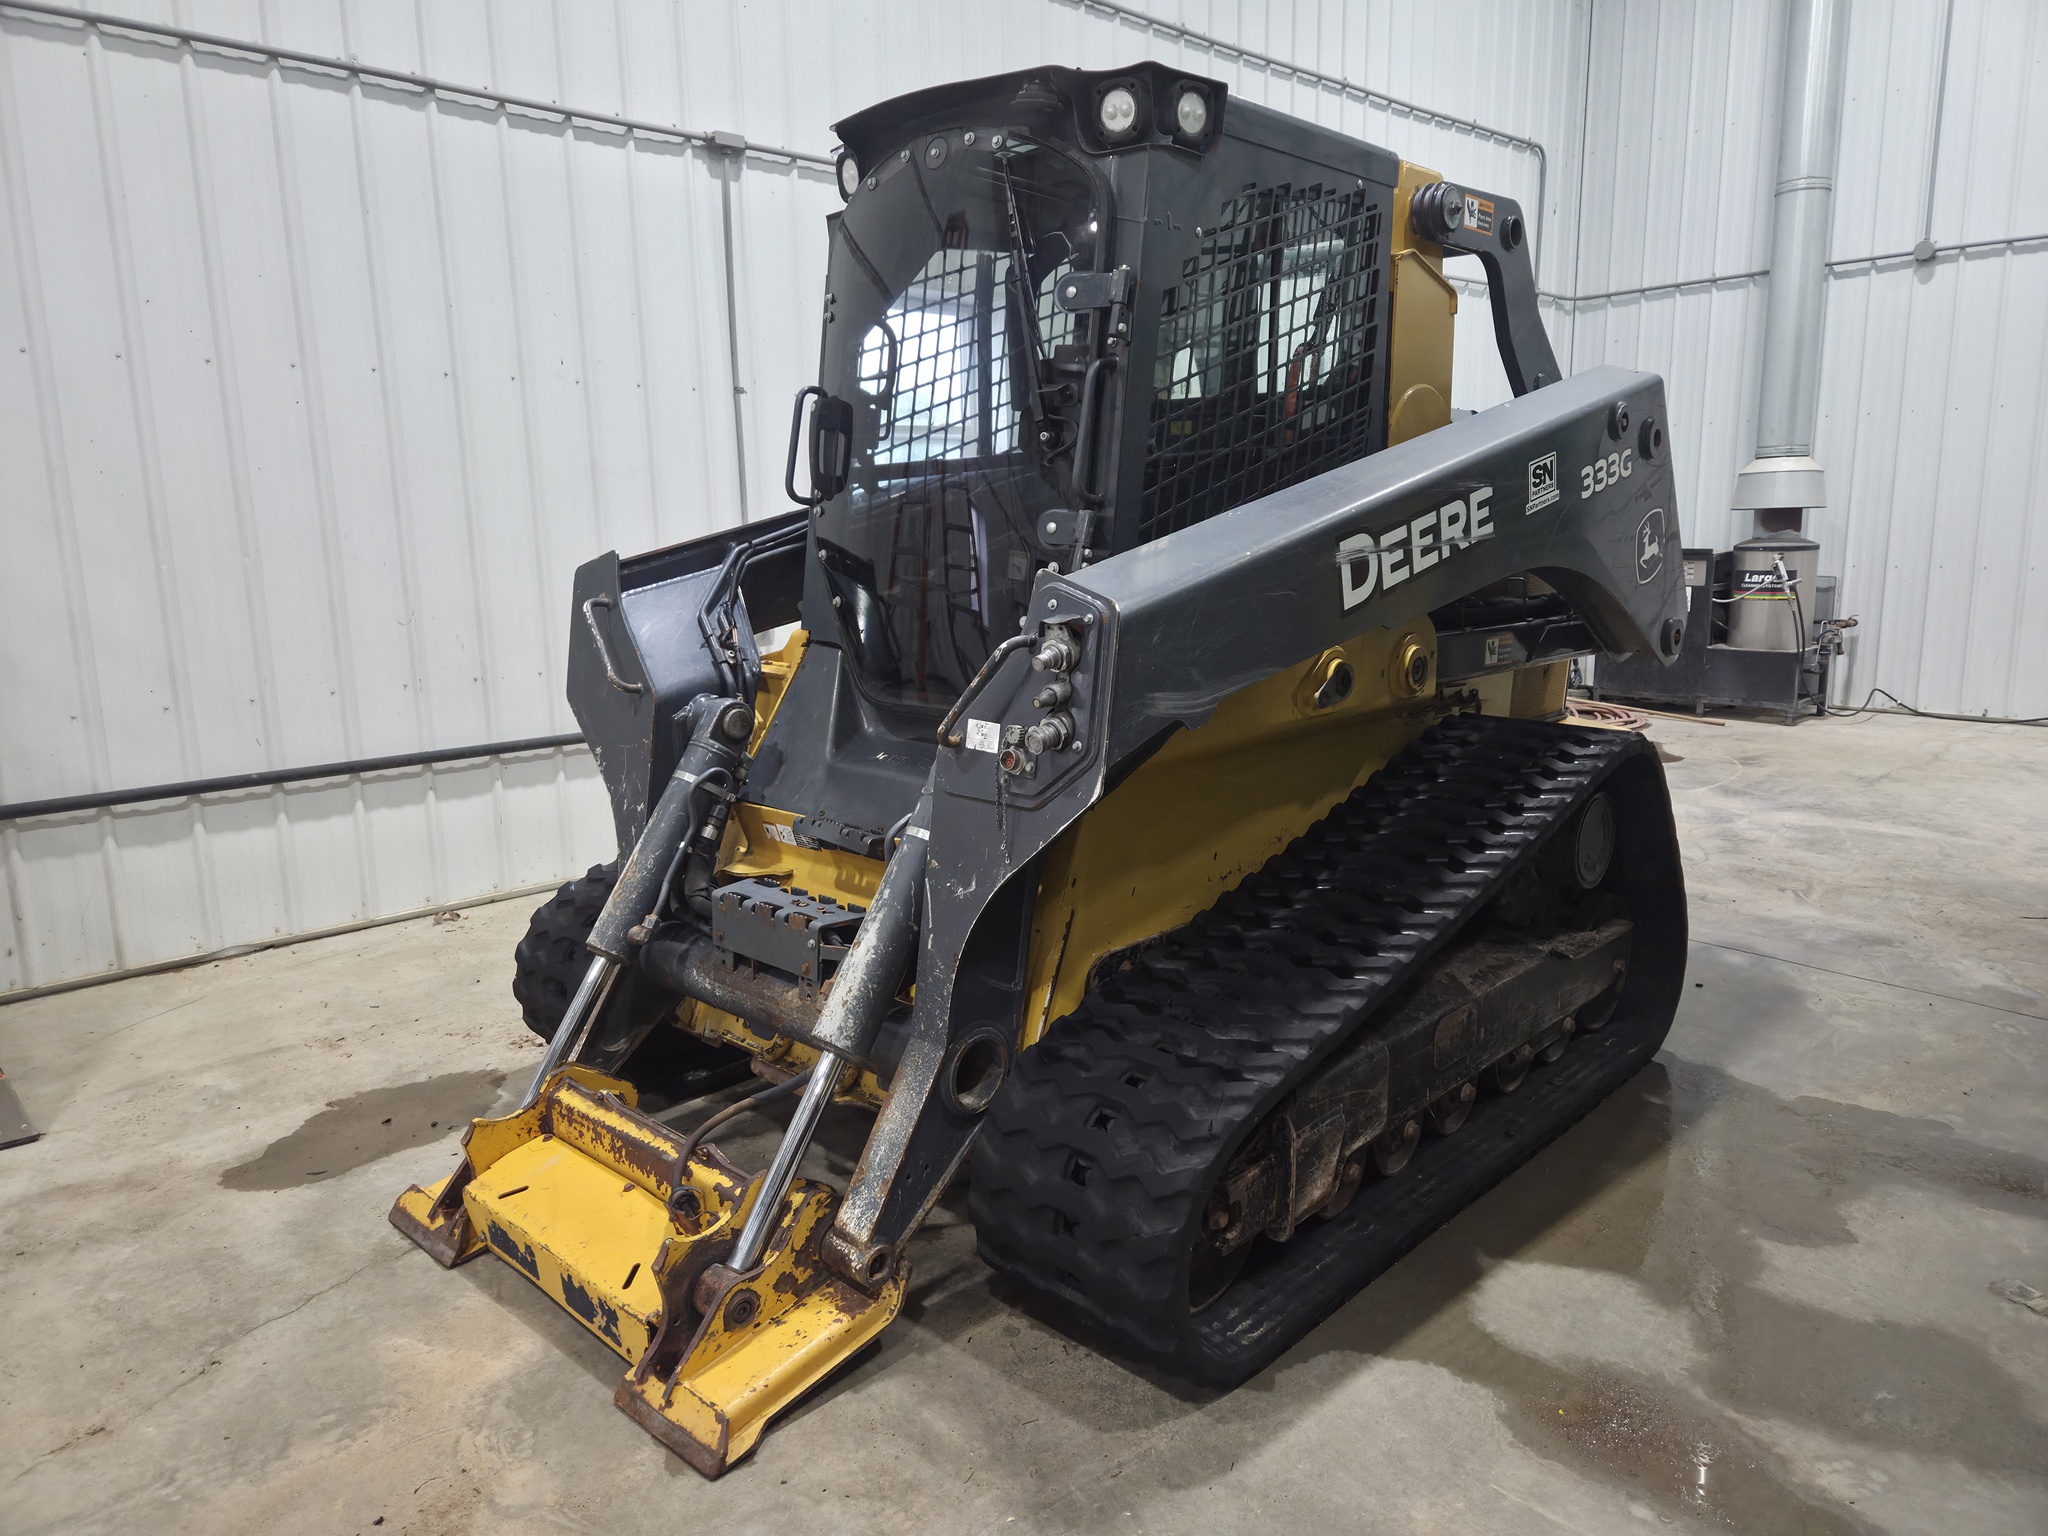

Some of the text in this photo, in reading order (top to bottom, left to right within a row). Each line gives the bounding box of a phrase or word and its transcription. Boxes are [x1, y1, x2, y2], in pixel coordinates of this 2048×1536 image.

[1532, 460, 1554, 489] SN
[1581, 448, 1632, 499] 333G
[1526, 493, 1560, 513] SNPartners.com
[1531, 481, 1554, 498] PARTNERS
[1338, 486, 1494, 611] DEERE
